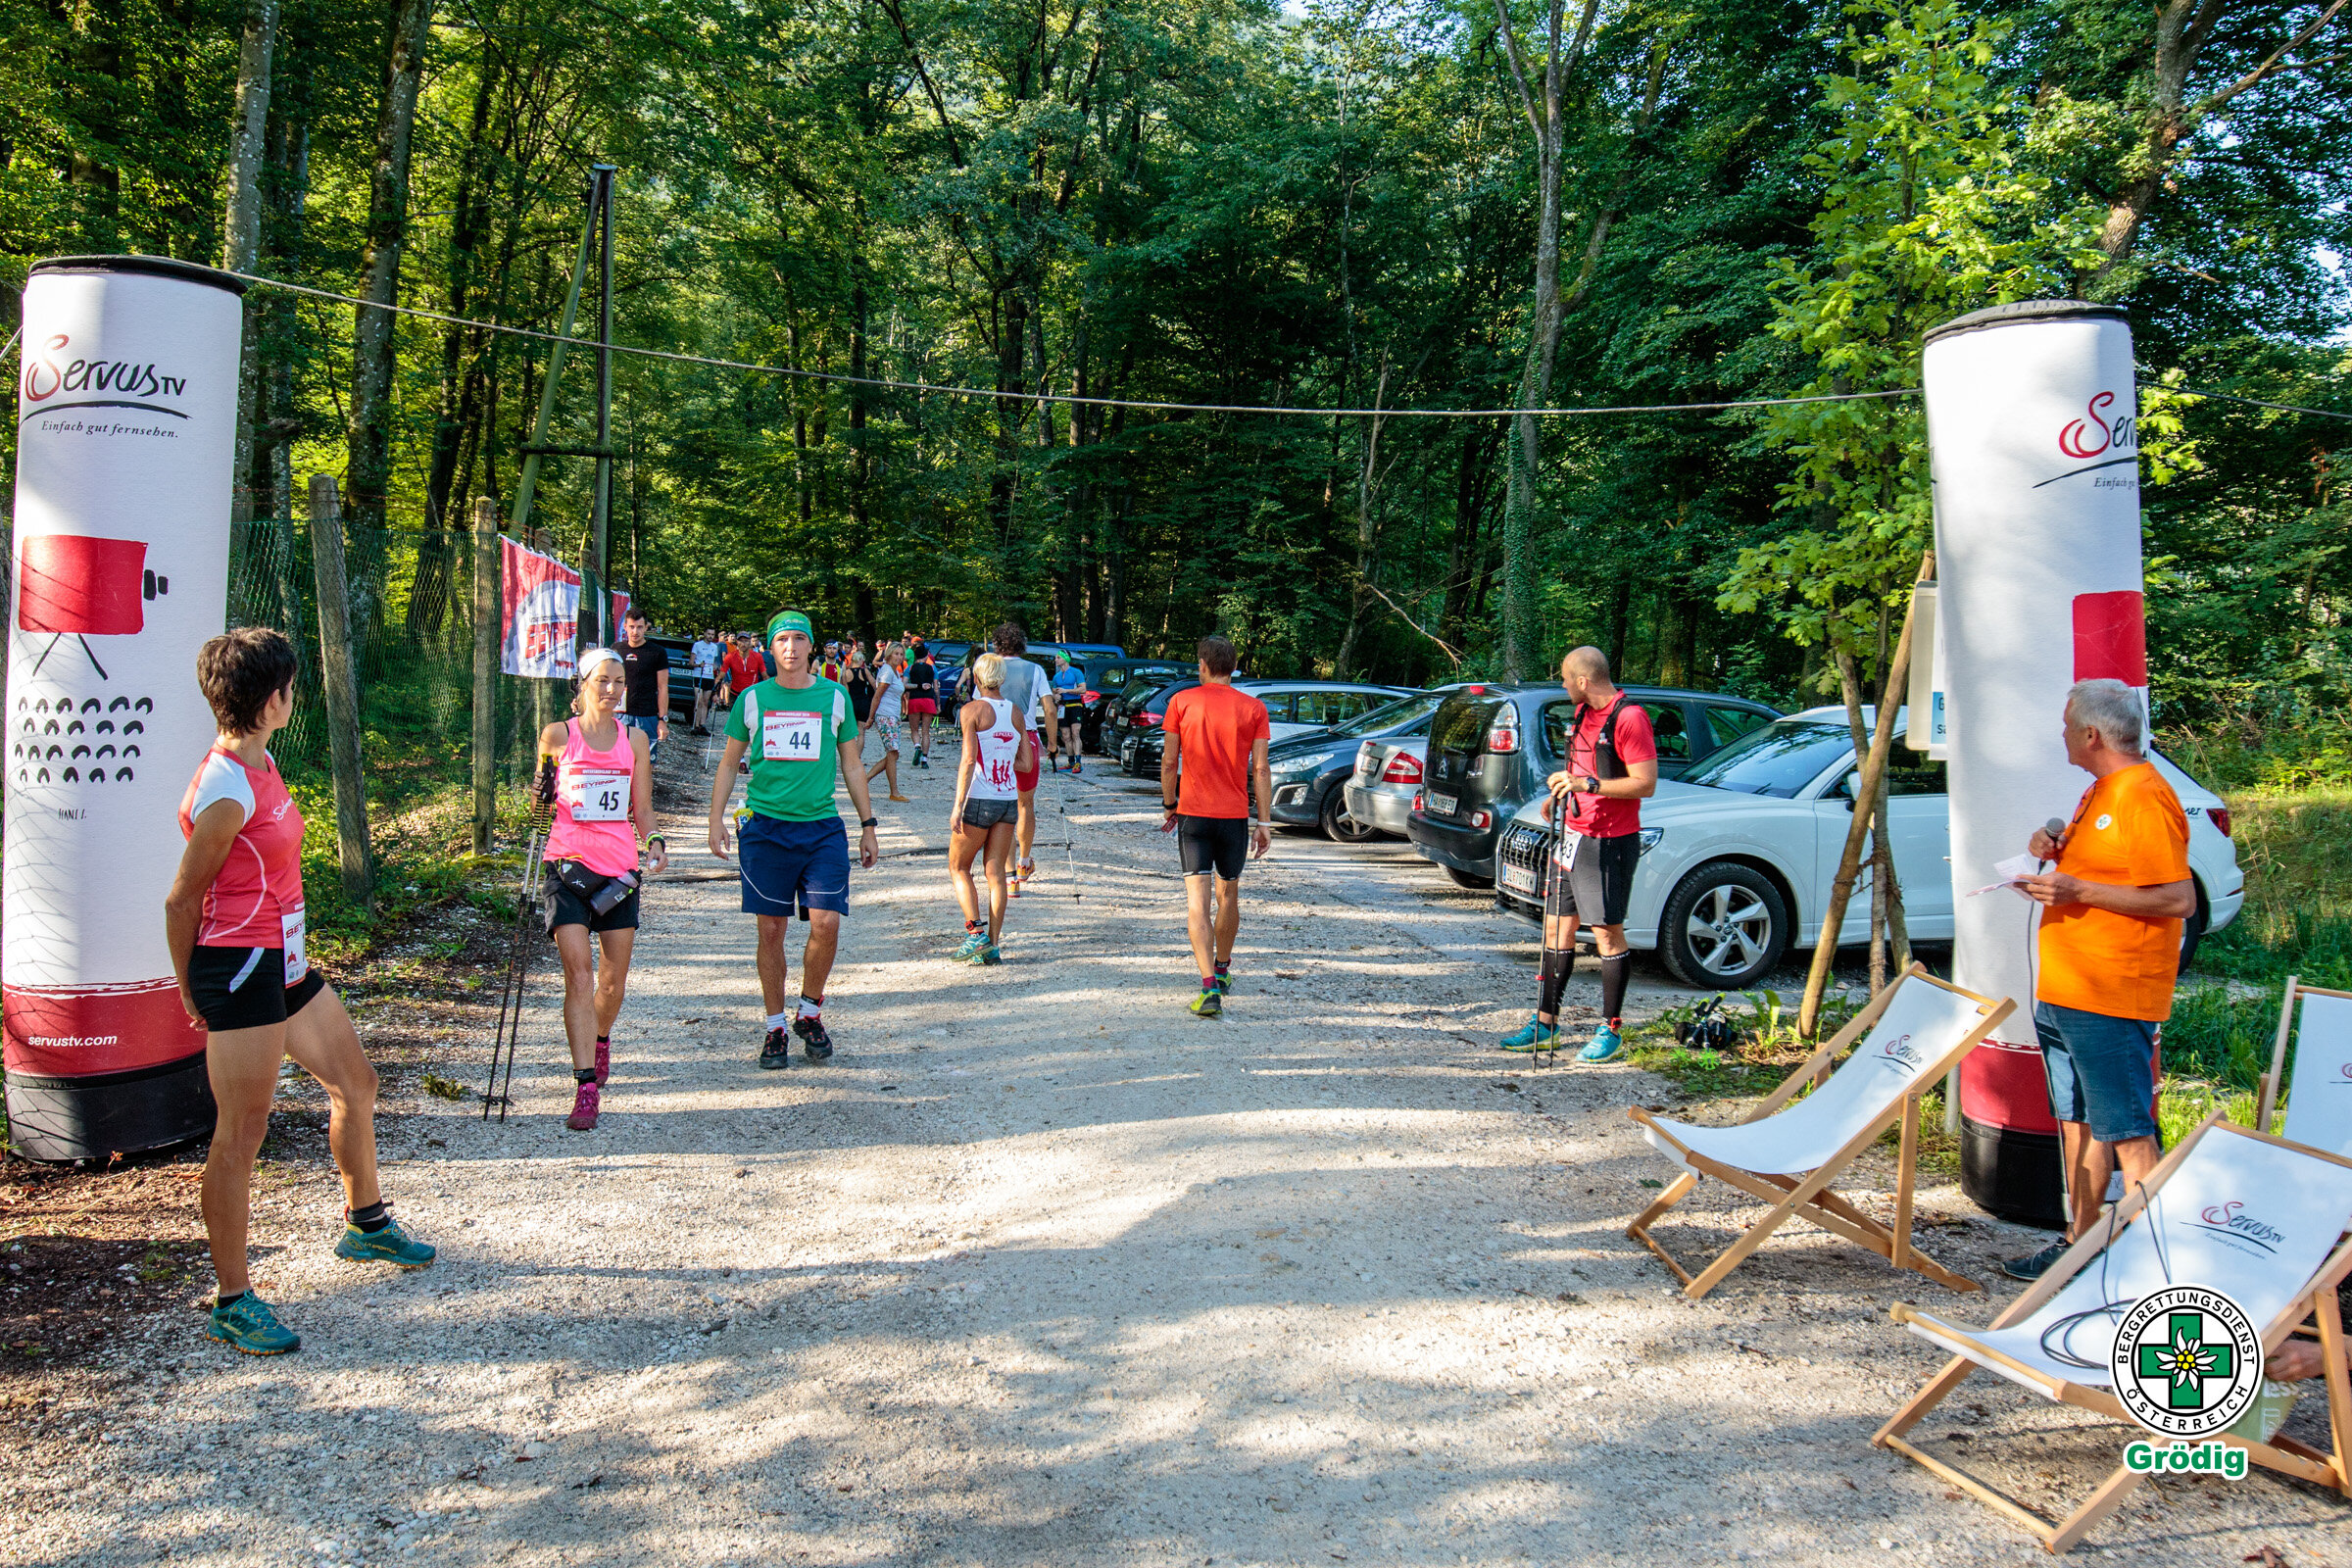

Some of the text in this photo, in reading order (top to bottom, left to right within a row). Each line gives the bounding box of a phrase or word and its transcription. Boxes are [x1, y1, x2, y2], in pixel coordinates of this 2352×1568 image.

[41, 420, 178, 438] Einfach gut fernsehen.
[2093, 477, 2127, 490] Einfach
[789, 731, 811, 751] 44
[598, 791, 620, 811] 45
[27, 1034, 118, 1048] servustv.com
